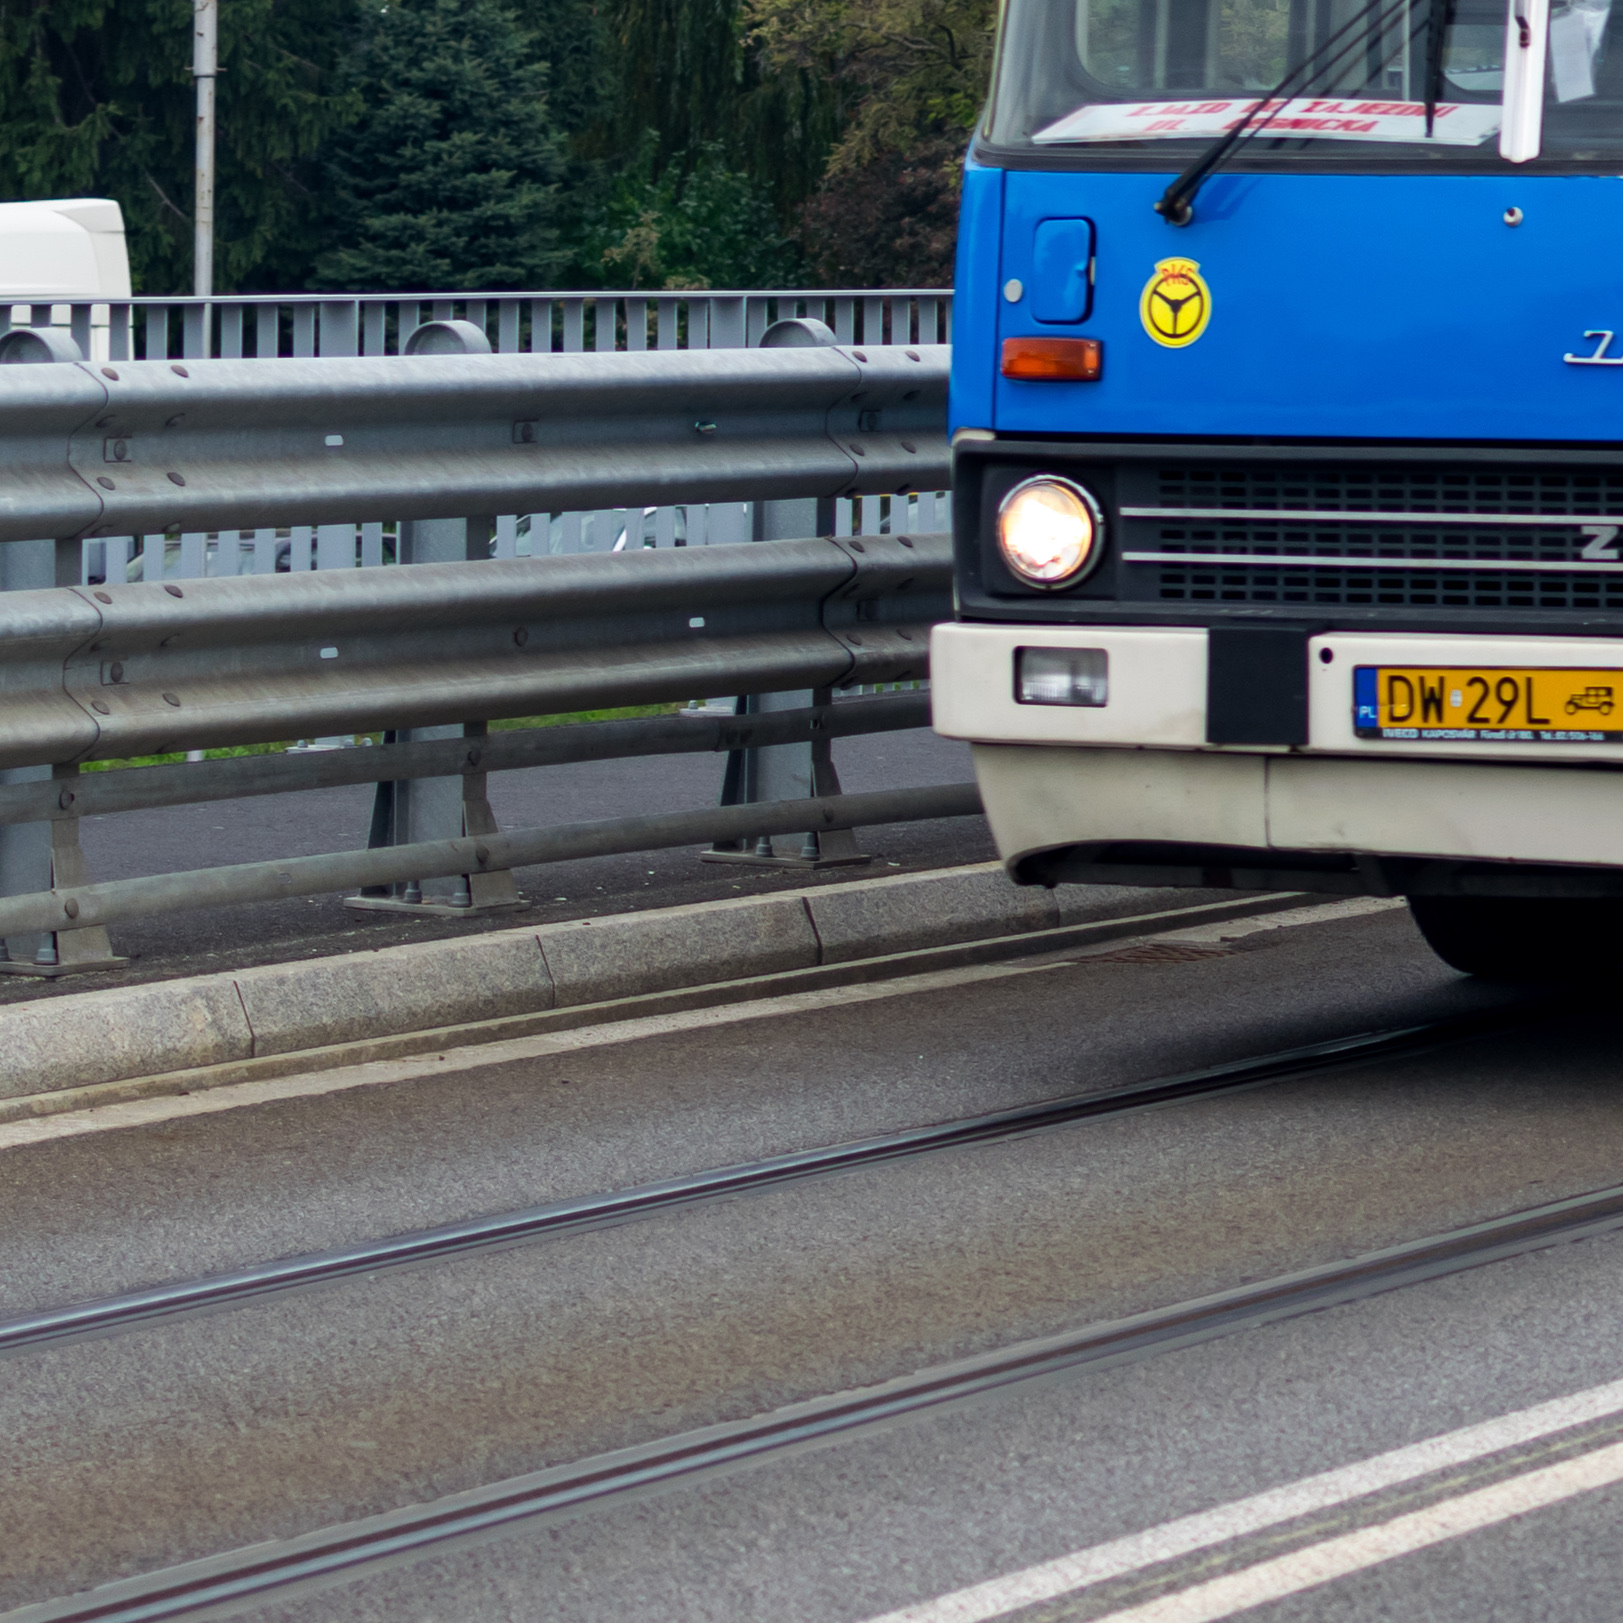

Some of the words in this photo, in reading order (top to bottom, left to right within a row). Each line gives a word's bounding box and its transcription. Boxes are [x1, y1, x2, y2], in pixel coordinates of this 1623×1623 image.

[1359, 705, 1377, 719] PL
[1387, 675, 1444, 724] DW
[1466, 676, 1551, 725] 29L
